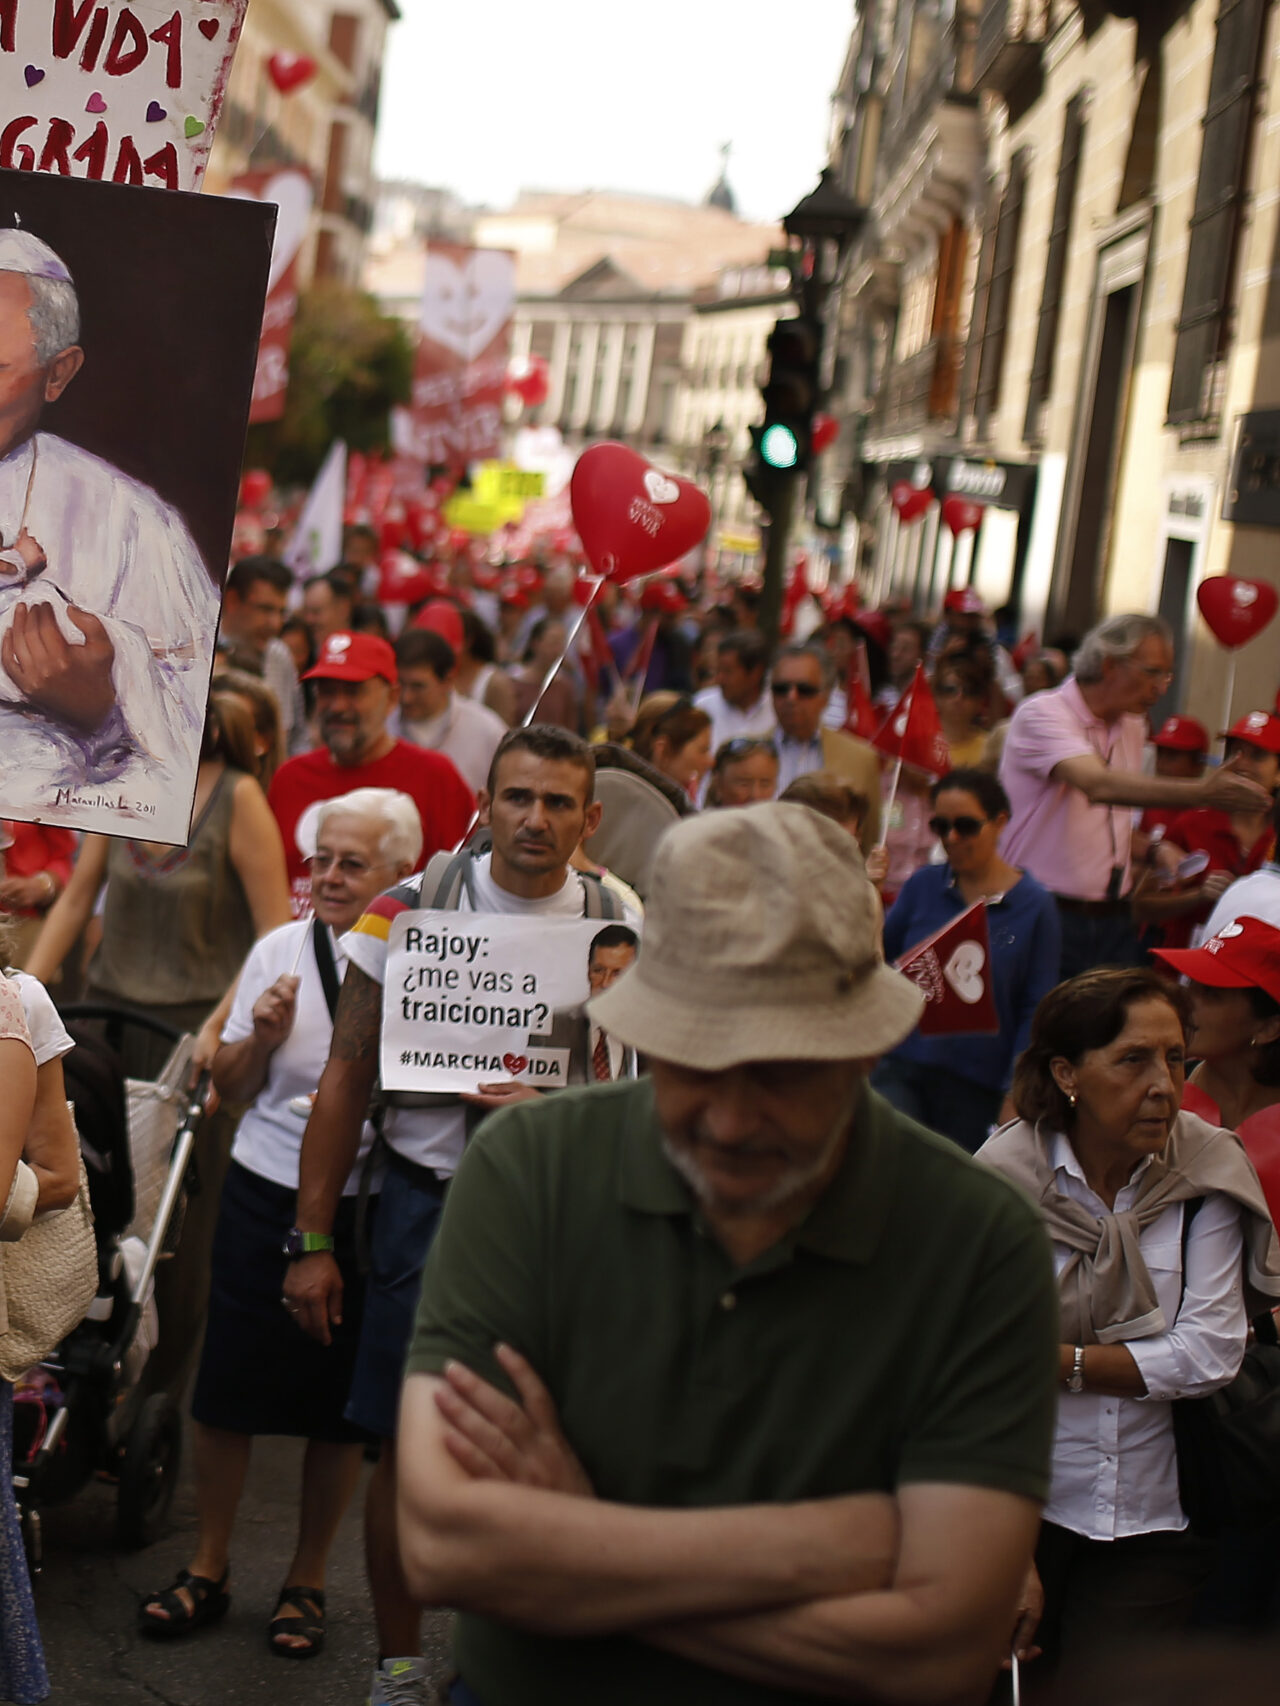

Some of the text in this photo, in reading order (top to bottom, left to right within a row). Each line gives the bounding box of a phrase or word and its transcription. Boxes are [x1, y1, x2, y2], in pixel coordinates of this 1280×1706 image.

[52, 0, 182, 89] VIDA
[405, 926, 490, 963] Rajoy:
[403, 963, 538, 995] ¿me vas a
[401, 994, 550, 1029] traicionar?
